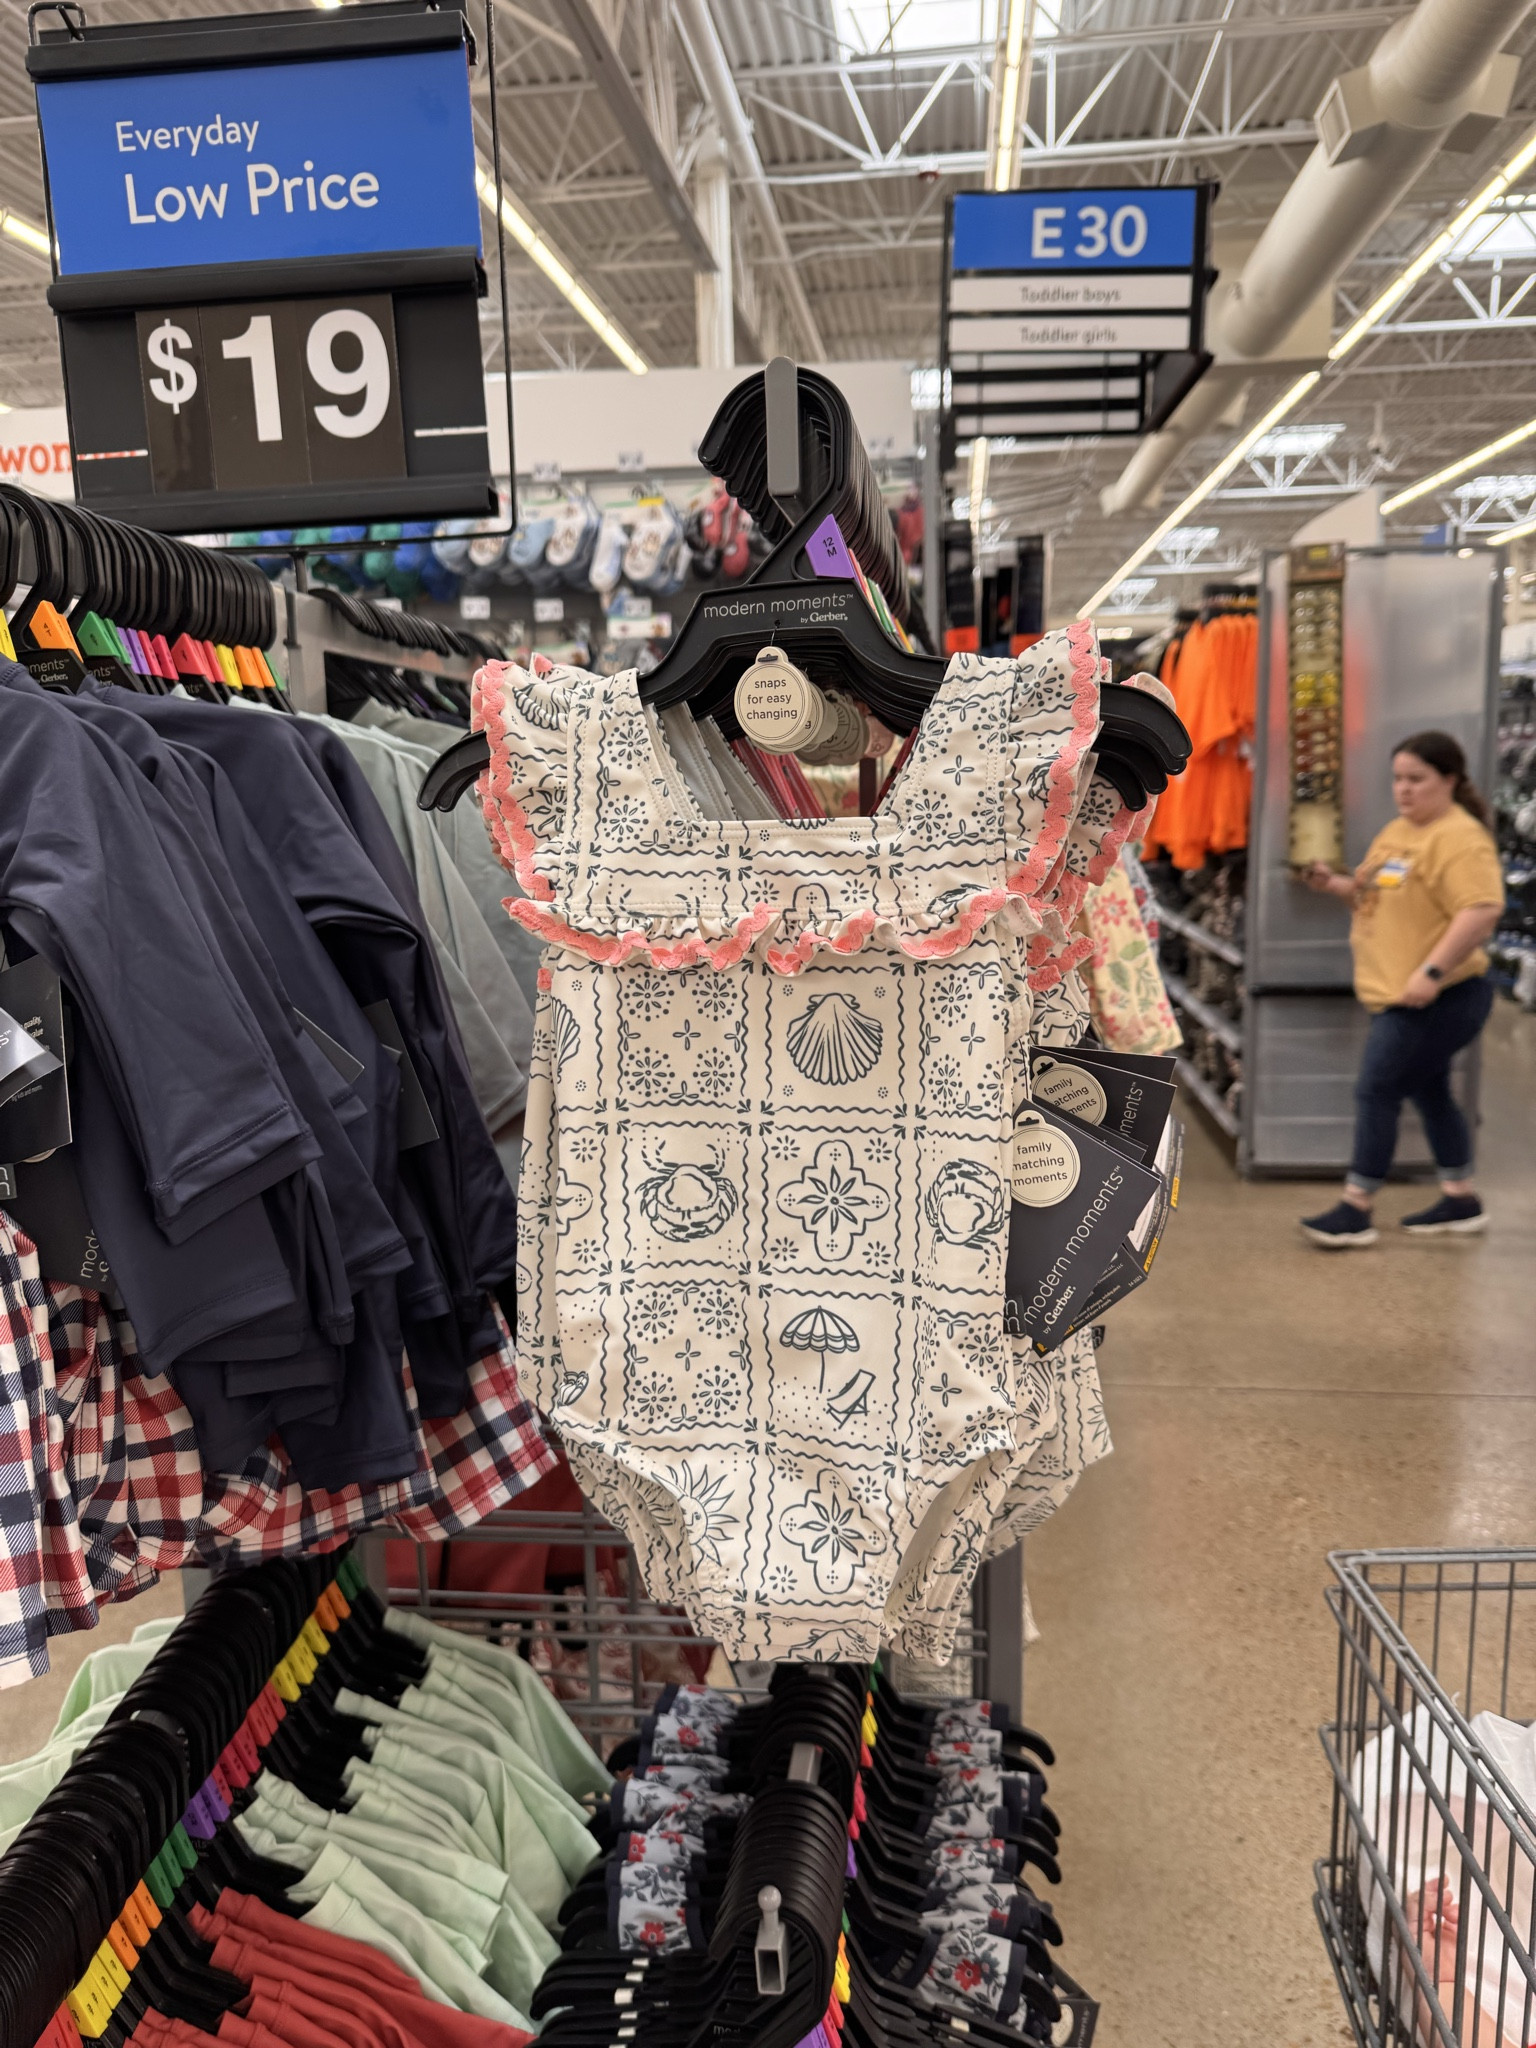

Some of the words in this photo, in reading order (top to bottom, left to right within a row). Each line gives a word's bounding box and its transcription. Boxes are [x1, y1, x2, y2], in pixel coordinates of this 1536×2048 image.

[116, 114, 259, 157] Everyday
[125, 173, 228, 224] Low
[246, 160, 379, 216] Price
[1031, 207, 1066, 258] E
[1074, 204, 1148, 258] 30
[1020, 286, 1079, 303] Toddler
[1082, 285, 1121, 305] boys
[1020, 326, 1078, 344] Toddler
[1082, 325, 1117, 345] girls
[822, 537, 834, 548] 12
[827, 546, 837, 558] M
[703, 601, 765, 618] modern
[754, 679, 787, 689] snaps
[747, 694, 763, 704] for
[766, 694, 792, 704] easy
[746, 708, 798, 720] changing
[1044, 1077, 1073, 1096] family
[1054, 1086, 1089, 1107] atching
[1068, 1097, 1097, 1115] ments
[1017, 1142, 1052, 1155] family
[1014, 1171, 1068, 1186] moments
[1024, 1256, 1072, 1325] modern
